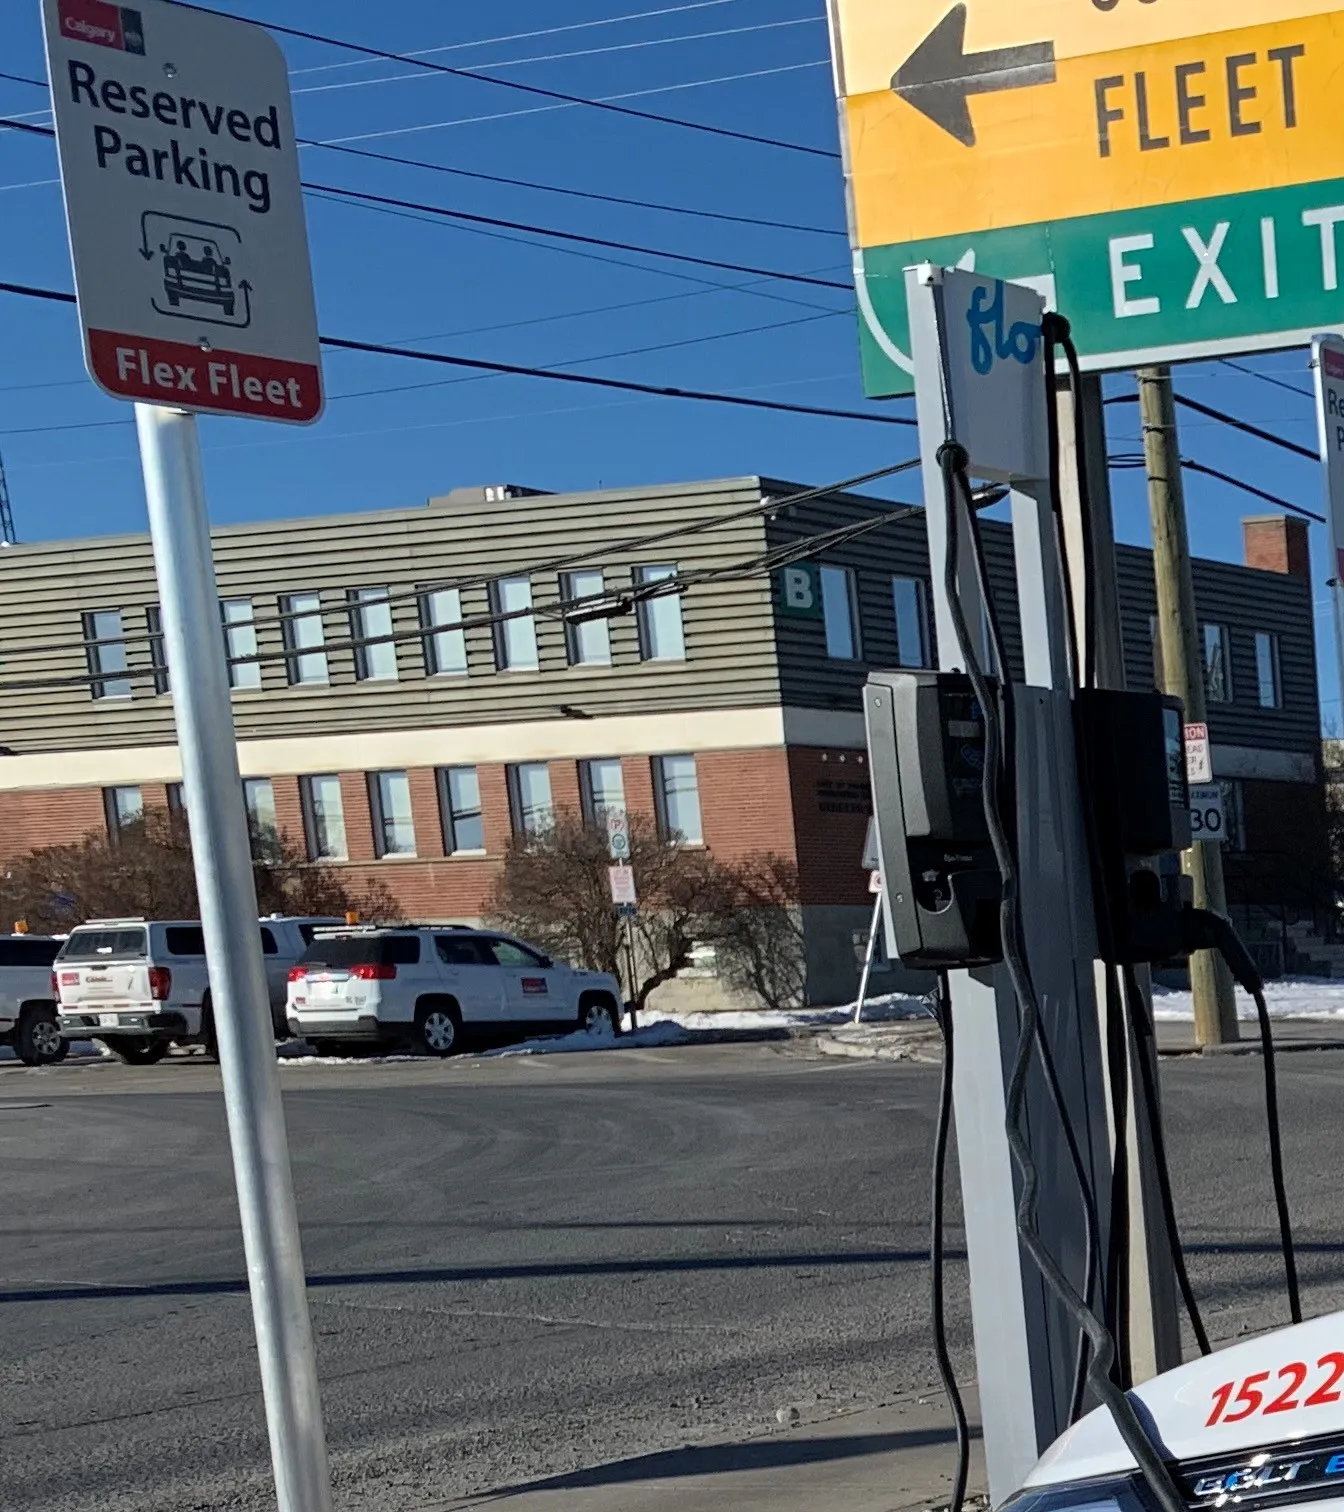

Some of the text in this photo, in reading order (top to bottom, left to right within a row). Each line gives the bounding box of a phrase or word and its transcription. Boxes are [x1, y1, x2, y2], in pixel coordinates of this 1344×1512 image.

[67, 60, 282, 150] Reserved
[1094, 44, 1305, 158] FLEET
[94, 125, 271, 213] Parking
[966, 278, 1043, 376] flo
[115, 346, 303, 408] Flex Fleet
[784, 568, 813, 608] B
